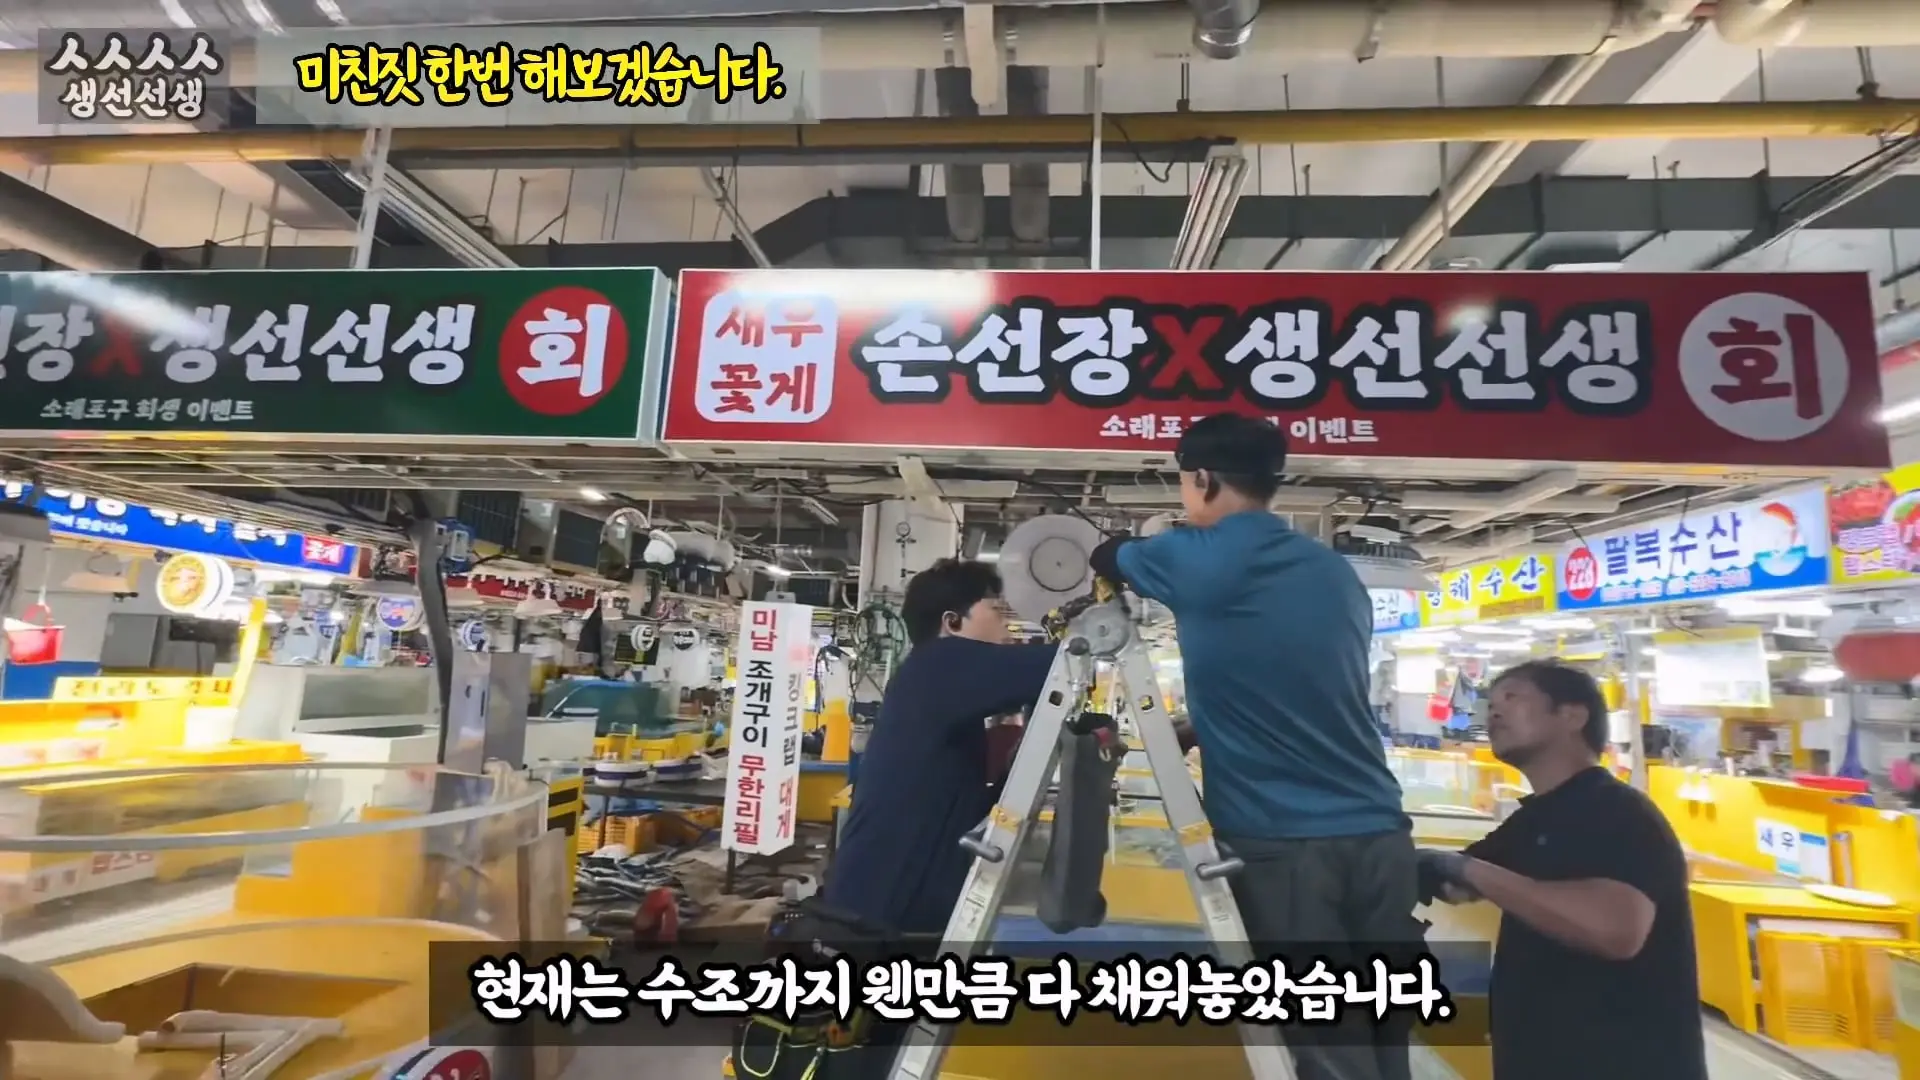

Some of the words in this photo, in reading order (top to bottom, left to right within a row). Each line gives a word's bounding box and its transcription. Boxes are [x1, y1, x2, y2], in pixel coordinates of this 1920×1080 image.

[517, 303, 609, 397] 회
[714, 303, 825, 348] 새우
[709, 363, 817, 414] 꽃게
[1706, 312, 1823, 420] 회
[40, 398, 130, 420] 소래포구
[187, 399, 255, 422] 이벤트
[1099, 413, 1206, 440] 소래포
[1290, 416, 1380, 444] 이벤트
[1604, 511, 1743, 577] 팔복수산
[749, 609, 778, 652] 미남
[741, 659, 774, 748] 조개구이
[732, 754, 767, 846] 무한리필
